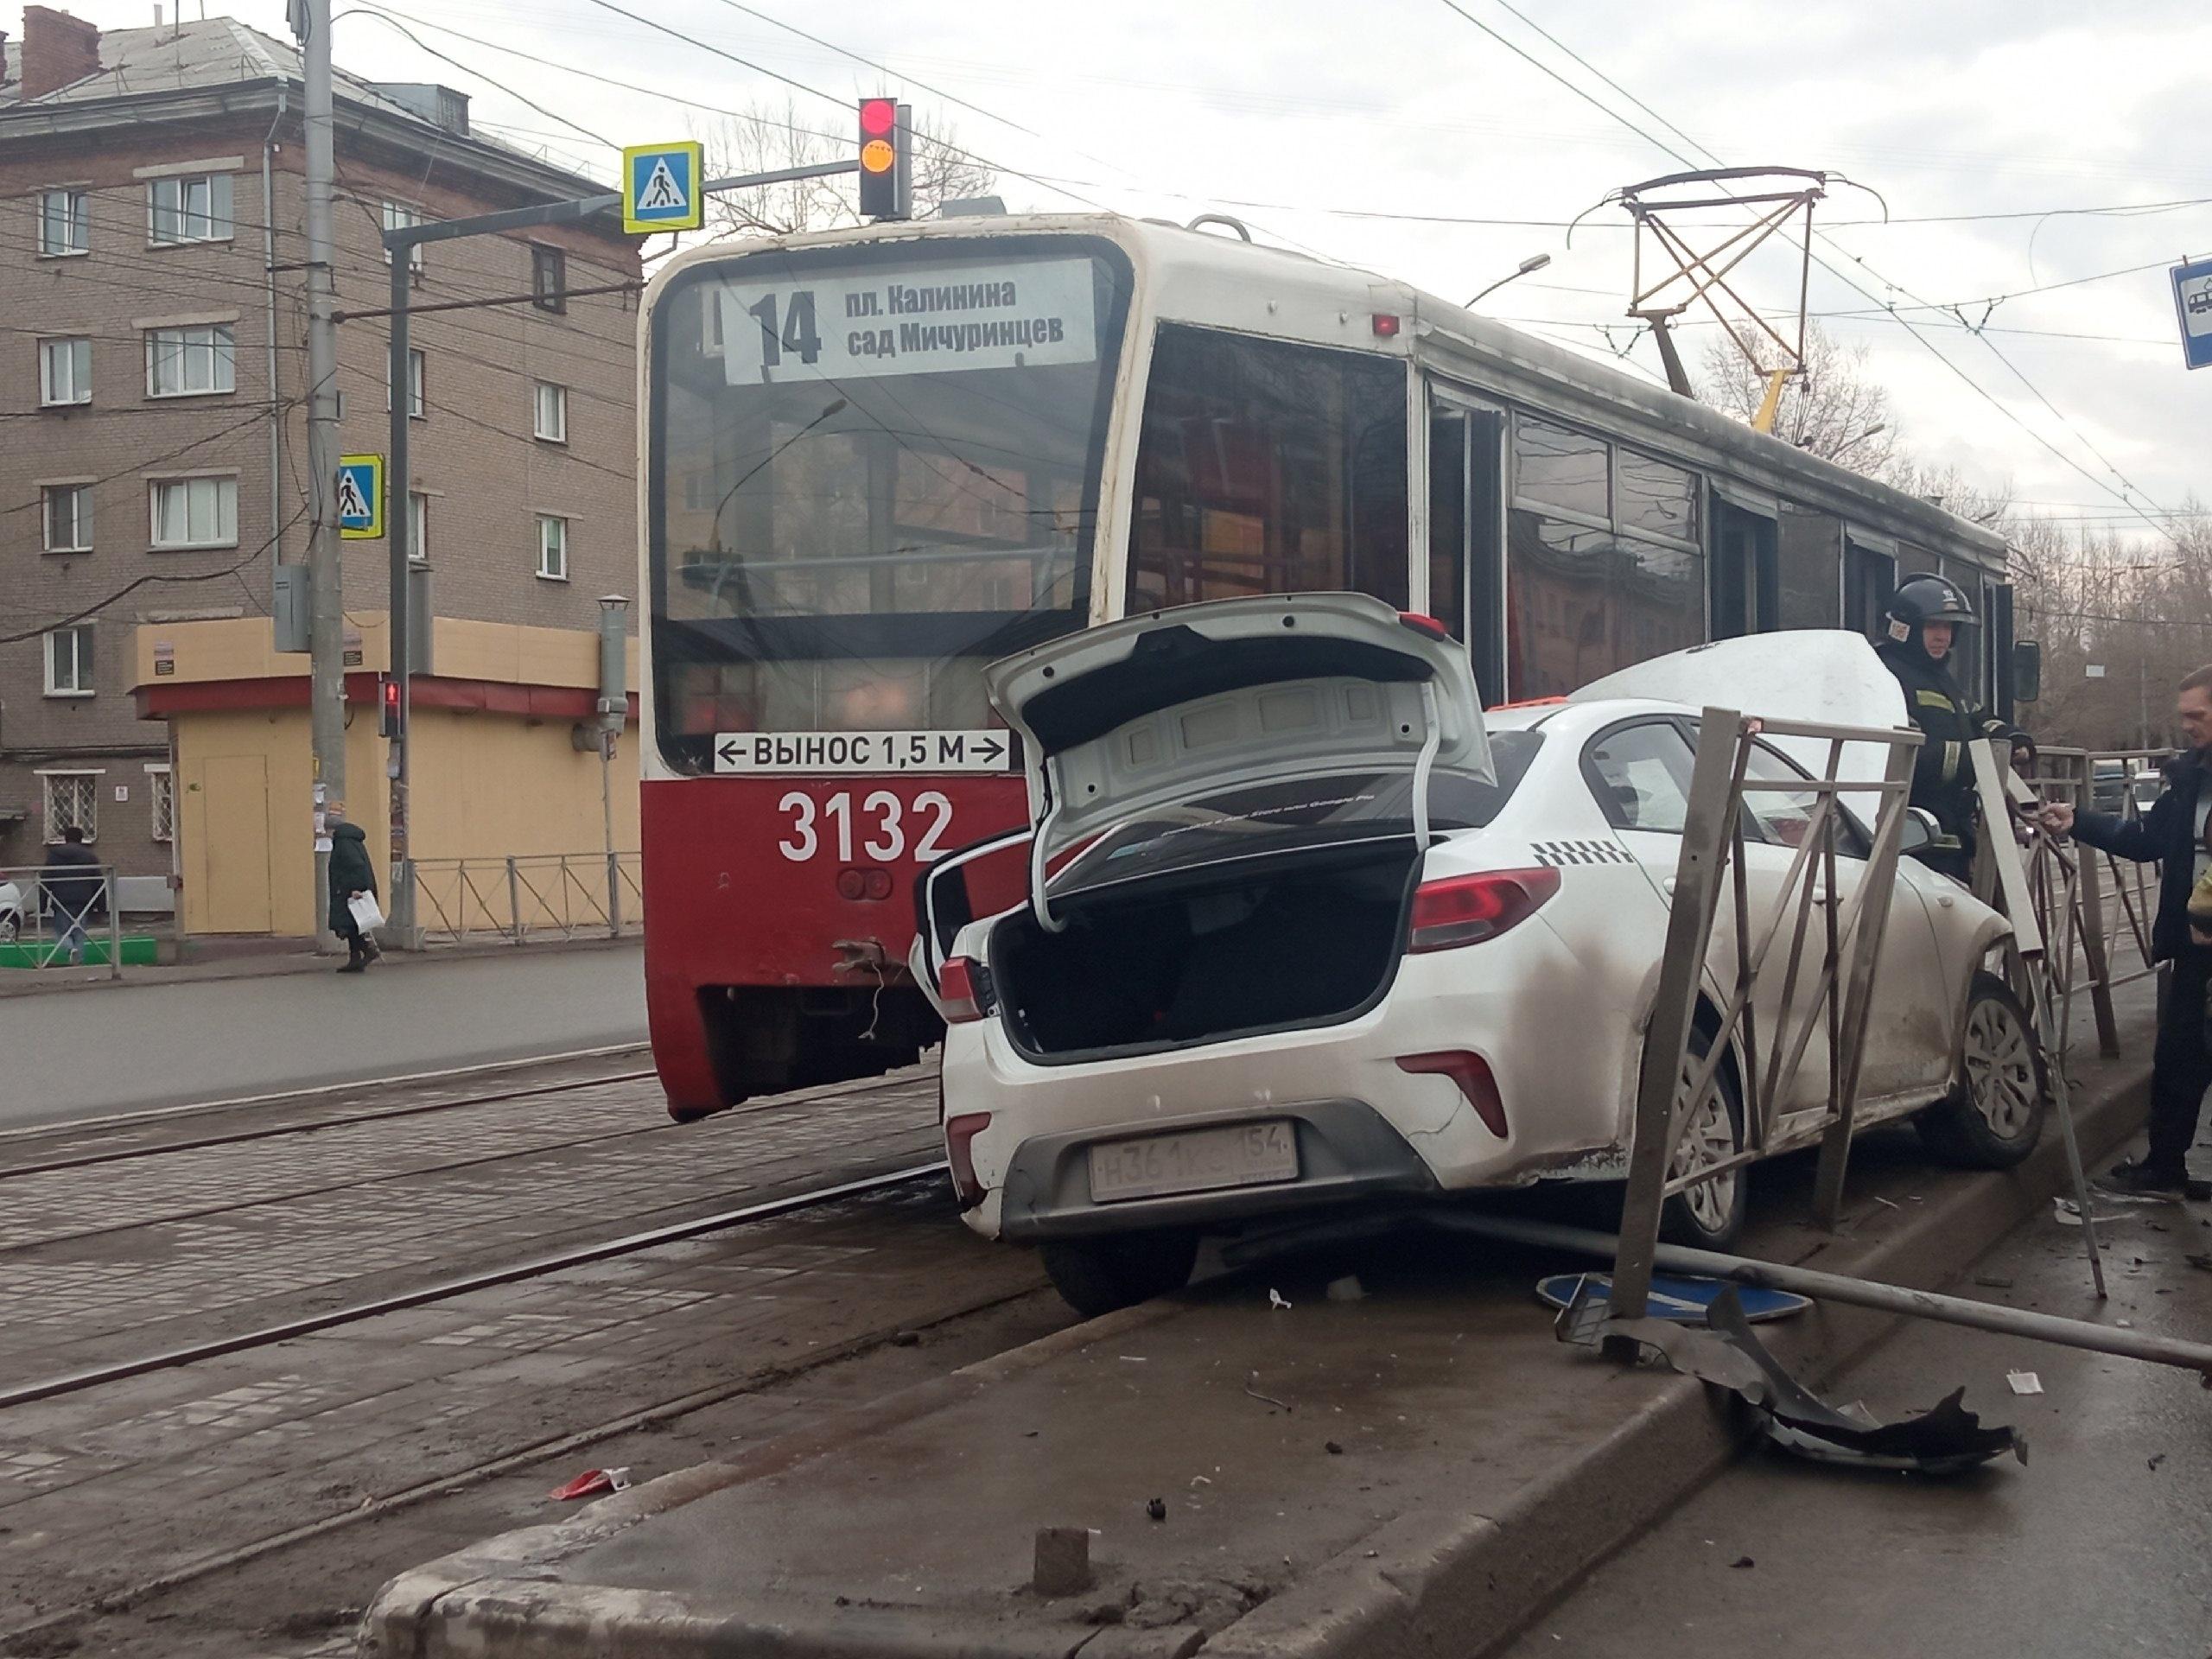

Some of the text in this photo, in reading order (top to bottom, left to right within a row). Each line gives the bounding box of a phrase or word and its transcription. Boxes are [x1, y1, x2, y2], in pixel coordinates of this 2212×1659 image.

[845, 281, 1016, 318] пл. Калинина
[749, 290, 822, 366] 14
[848, 316, 1064, 359] сад Мичуринцев
[754, 734, 964, 769] ВЫНОС 1,5 М
[778, 790, 954, 862] 3132
